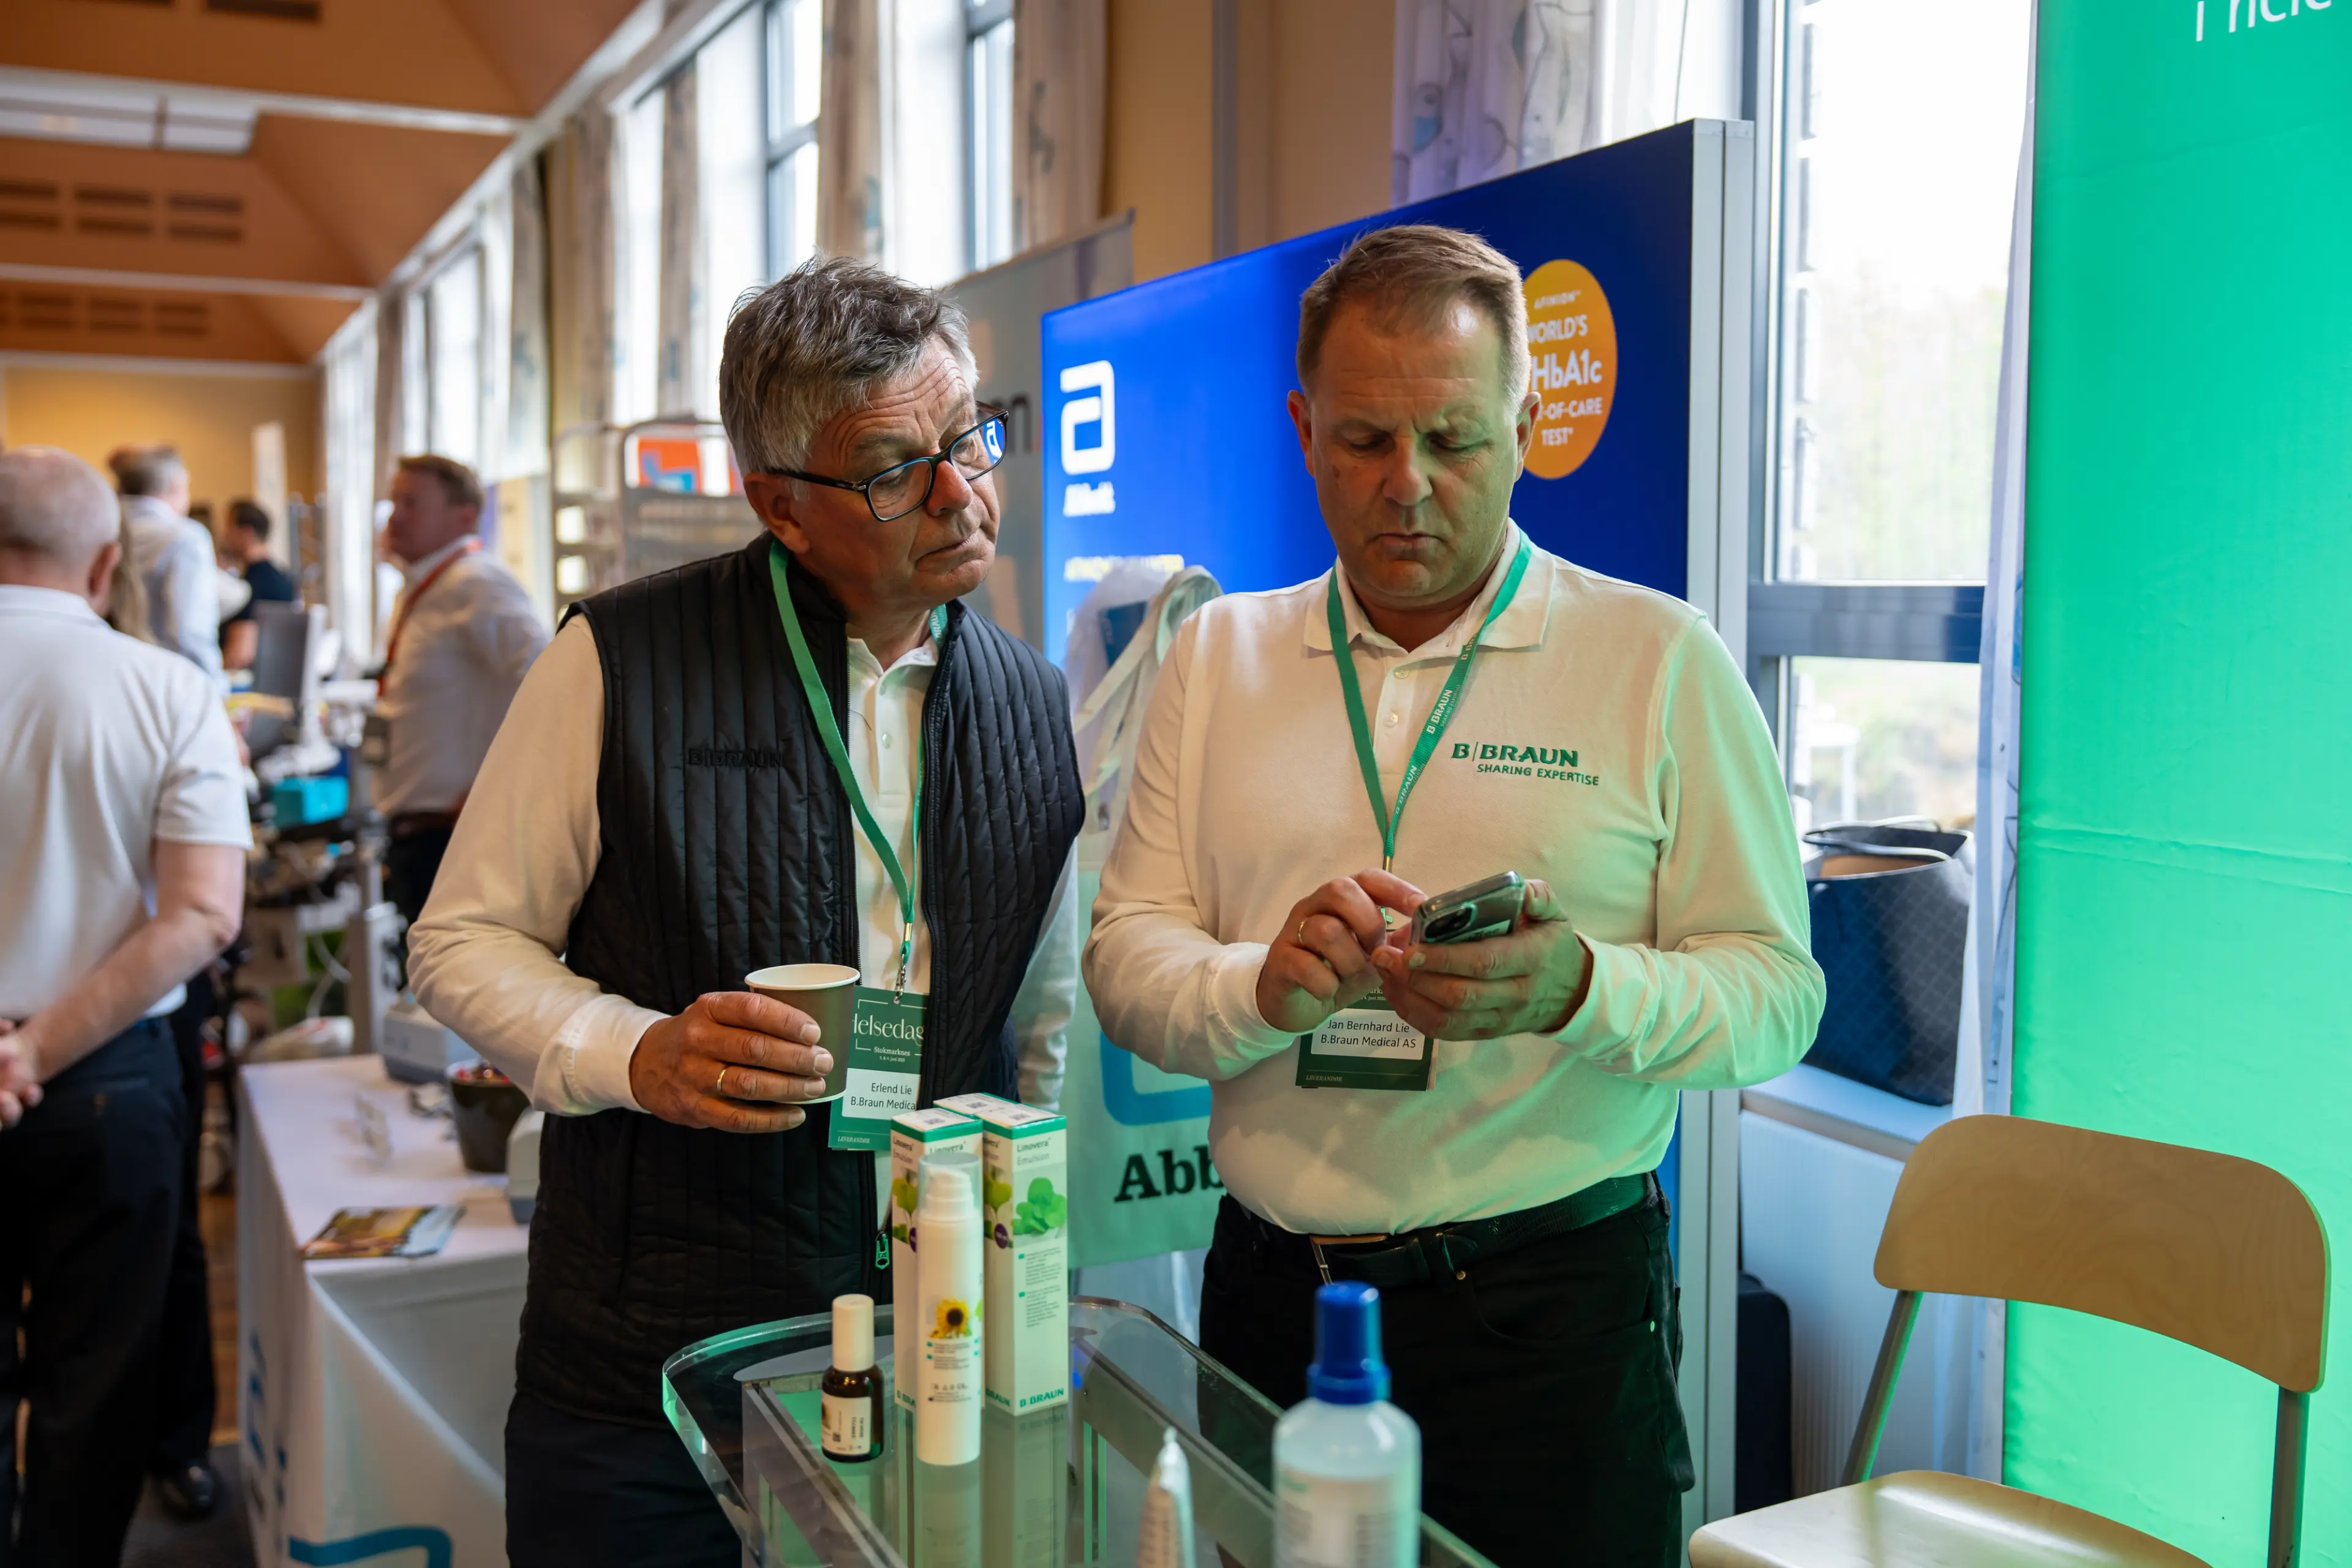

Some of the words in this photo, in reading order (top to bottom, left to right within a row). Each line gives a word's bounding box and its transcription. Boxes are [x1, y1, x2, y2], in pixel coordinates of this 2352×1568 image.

[1532, 349, 1602, 390] HbA1c
[1431, 689, 1452, 724] BRAUN
[1477, 764, 1532, 777] SHARING
[1537, 768, 1599, 786] EXPERTISE
[1327, 1020, 1344, 1029] Jan
[1347, 1020, 1392, 1032] Bernhard
[1395, 1023, 1410, 1033] Lie
[1321, 1035, 1359, 1045] B.Braun
[1362, 1036, 1399, 1047] Medical
[1402, 1039, 1416, 1048] AS
[874, 1046, 911, 1057] Stokmarknes
[871, 1082, 898, 1094] Erlend
[900, 1085, 913, 1095] Lie
[851, 1096, 884, 1108] B.Braun
[837, 1136, 870, 1144] LEVERANDØR
[1030, 1387, 1065, 1405] BRAUN
